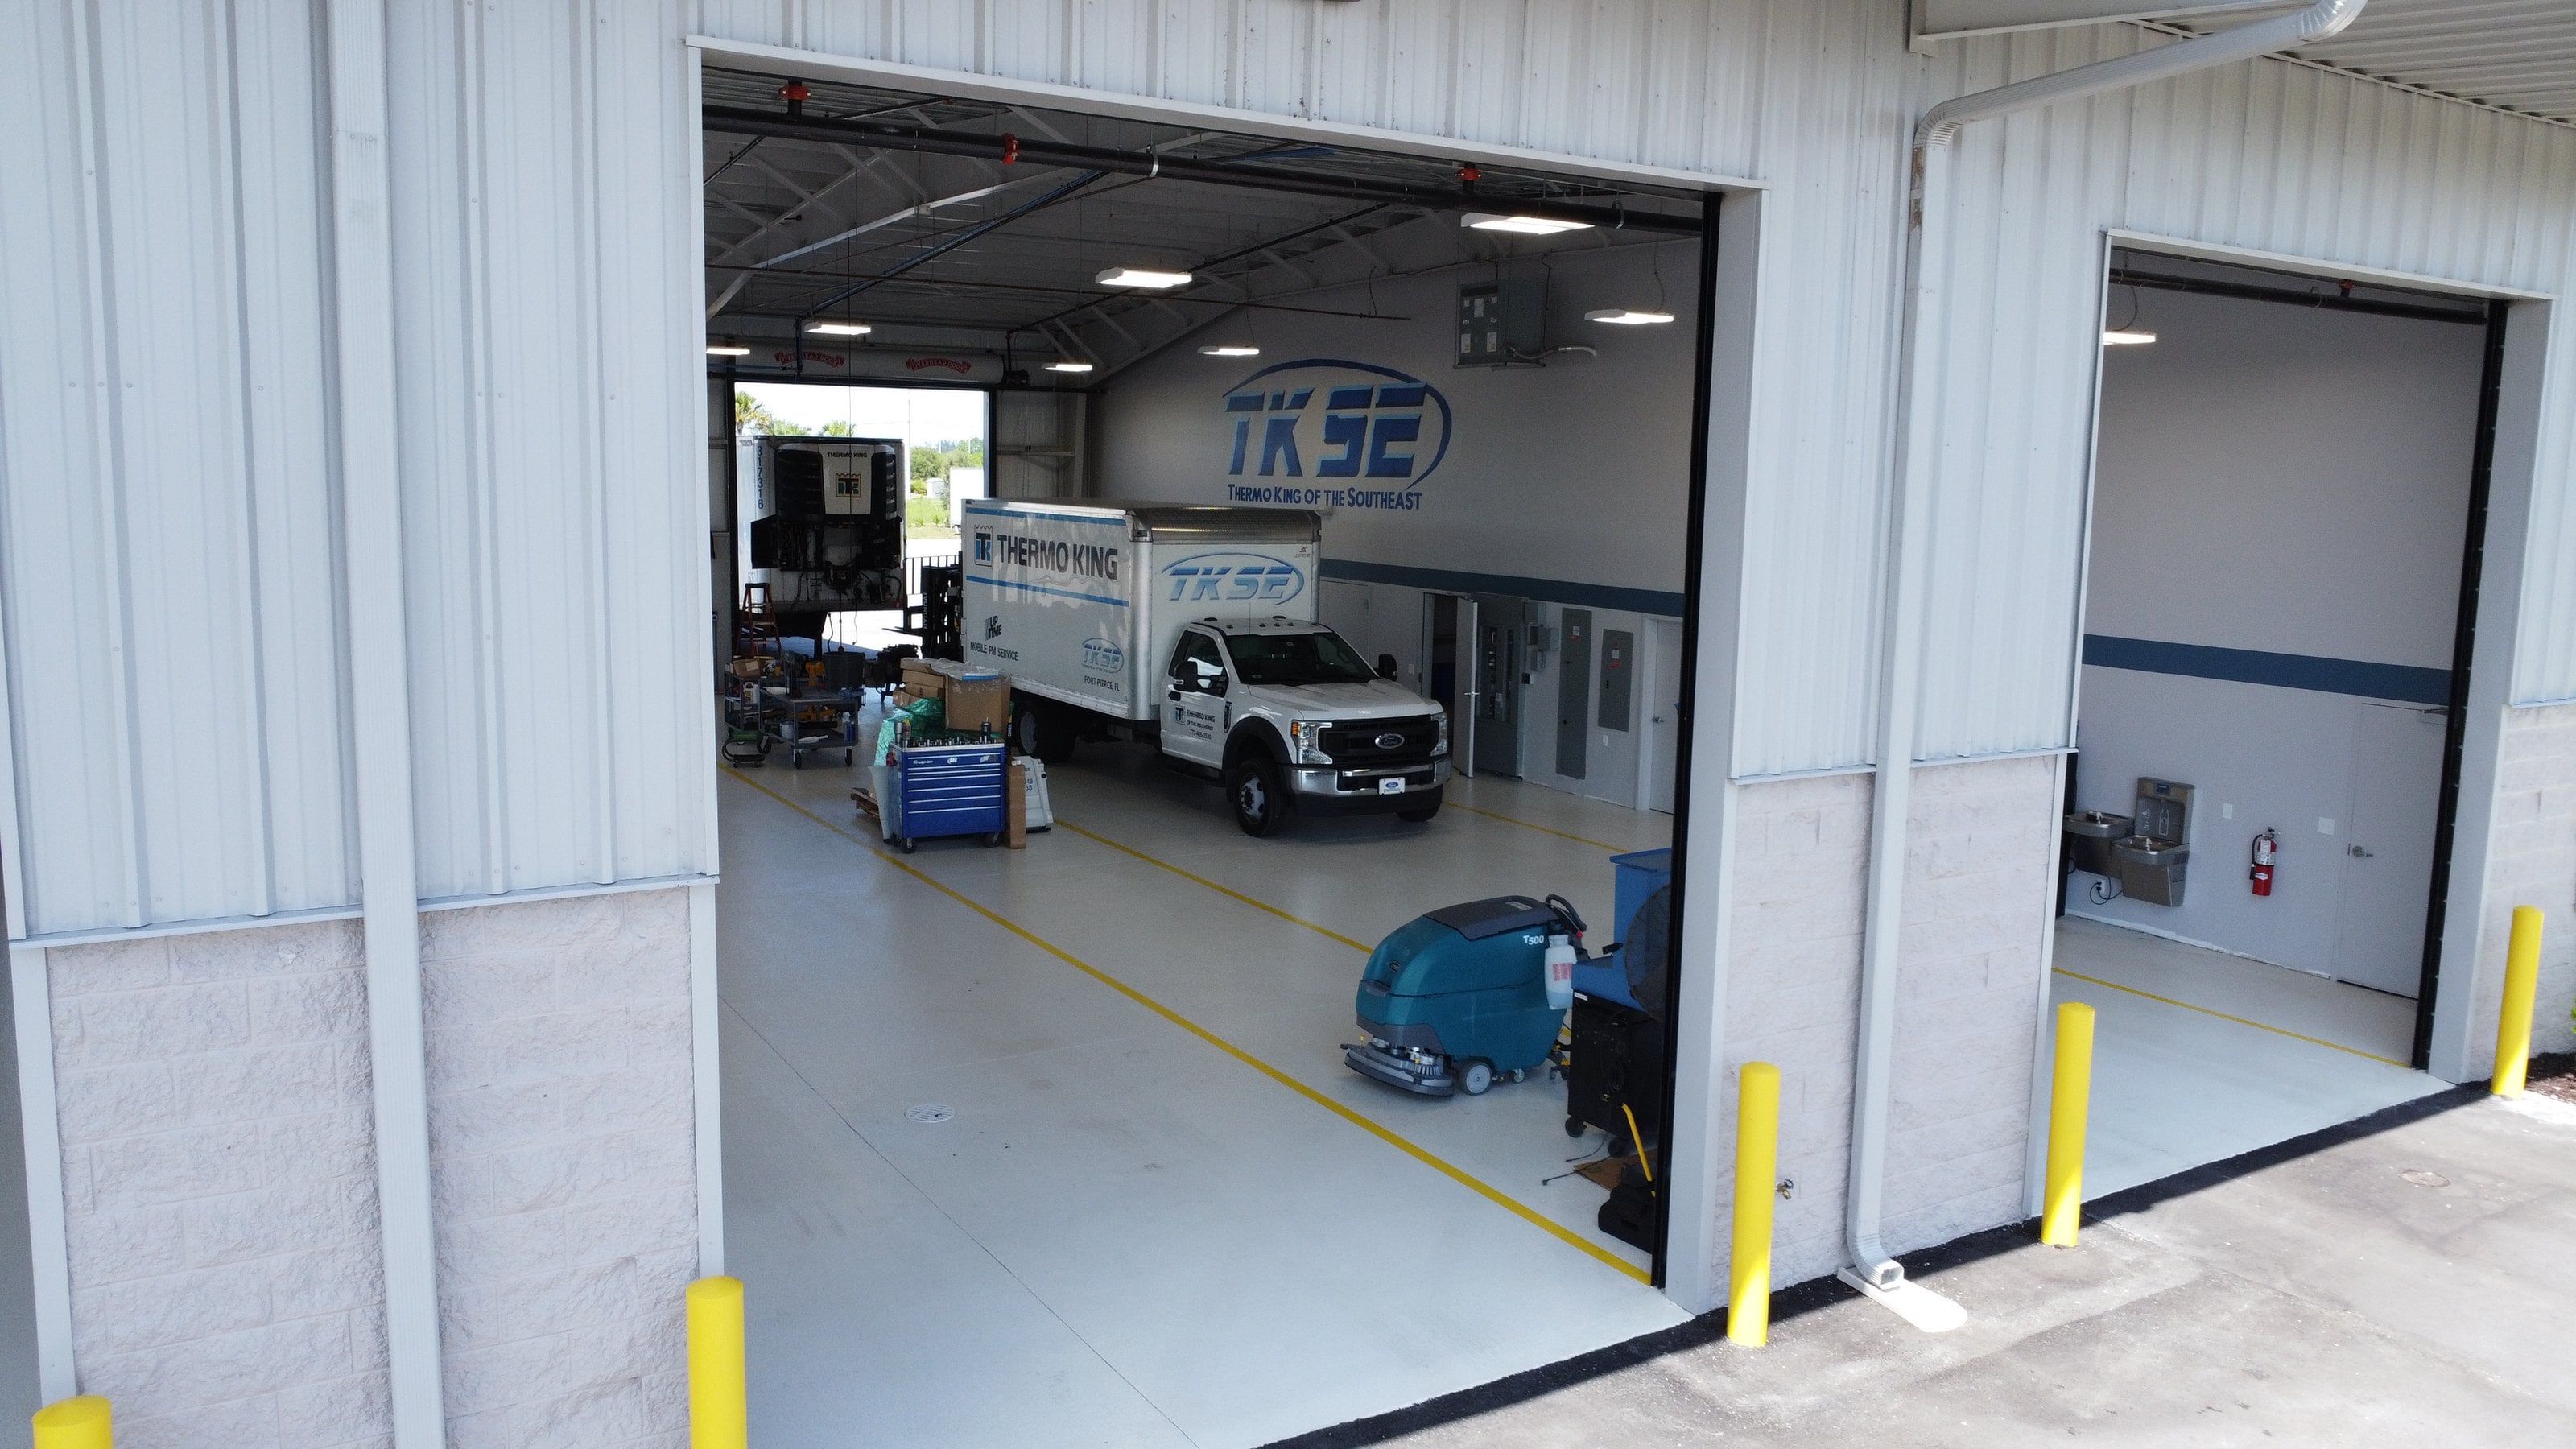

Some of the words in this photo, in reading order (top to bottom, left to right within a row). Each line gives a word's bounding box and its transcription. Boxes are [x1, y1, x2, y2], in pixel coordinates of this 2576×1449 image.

[997, 534, 1069, 573] THERMO
[1073, 543, 1118, 580] KING
[970, 642, 987, 654] MOBILE
[989, 645, 997, 656] PM
[997, 647, 1018, 661] SERVICE
[1084, 675, 1096, 685] FORT
[1114, 683, 1120, 691] FL
[1523, 935, 1545, 946] T500
